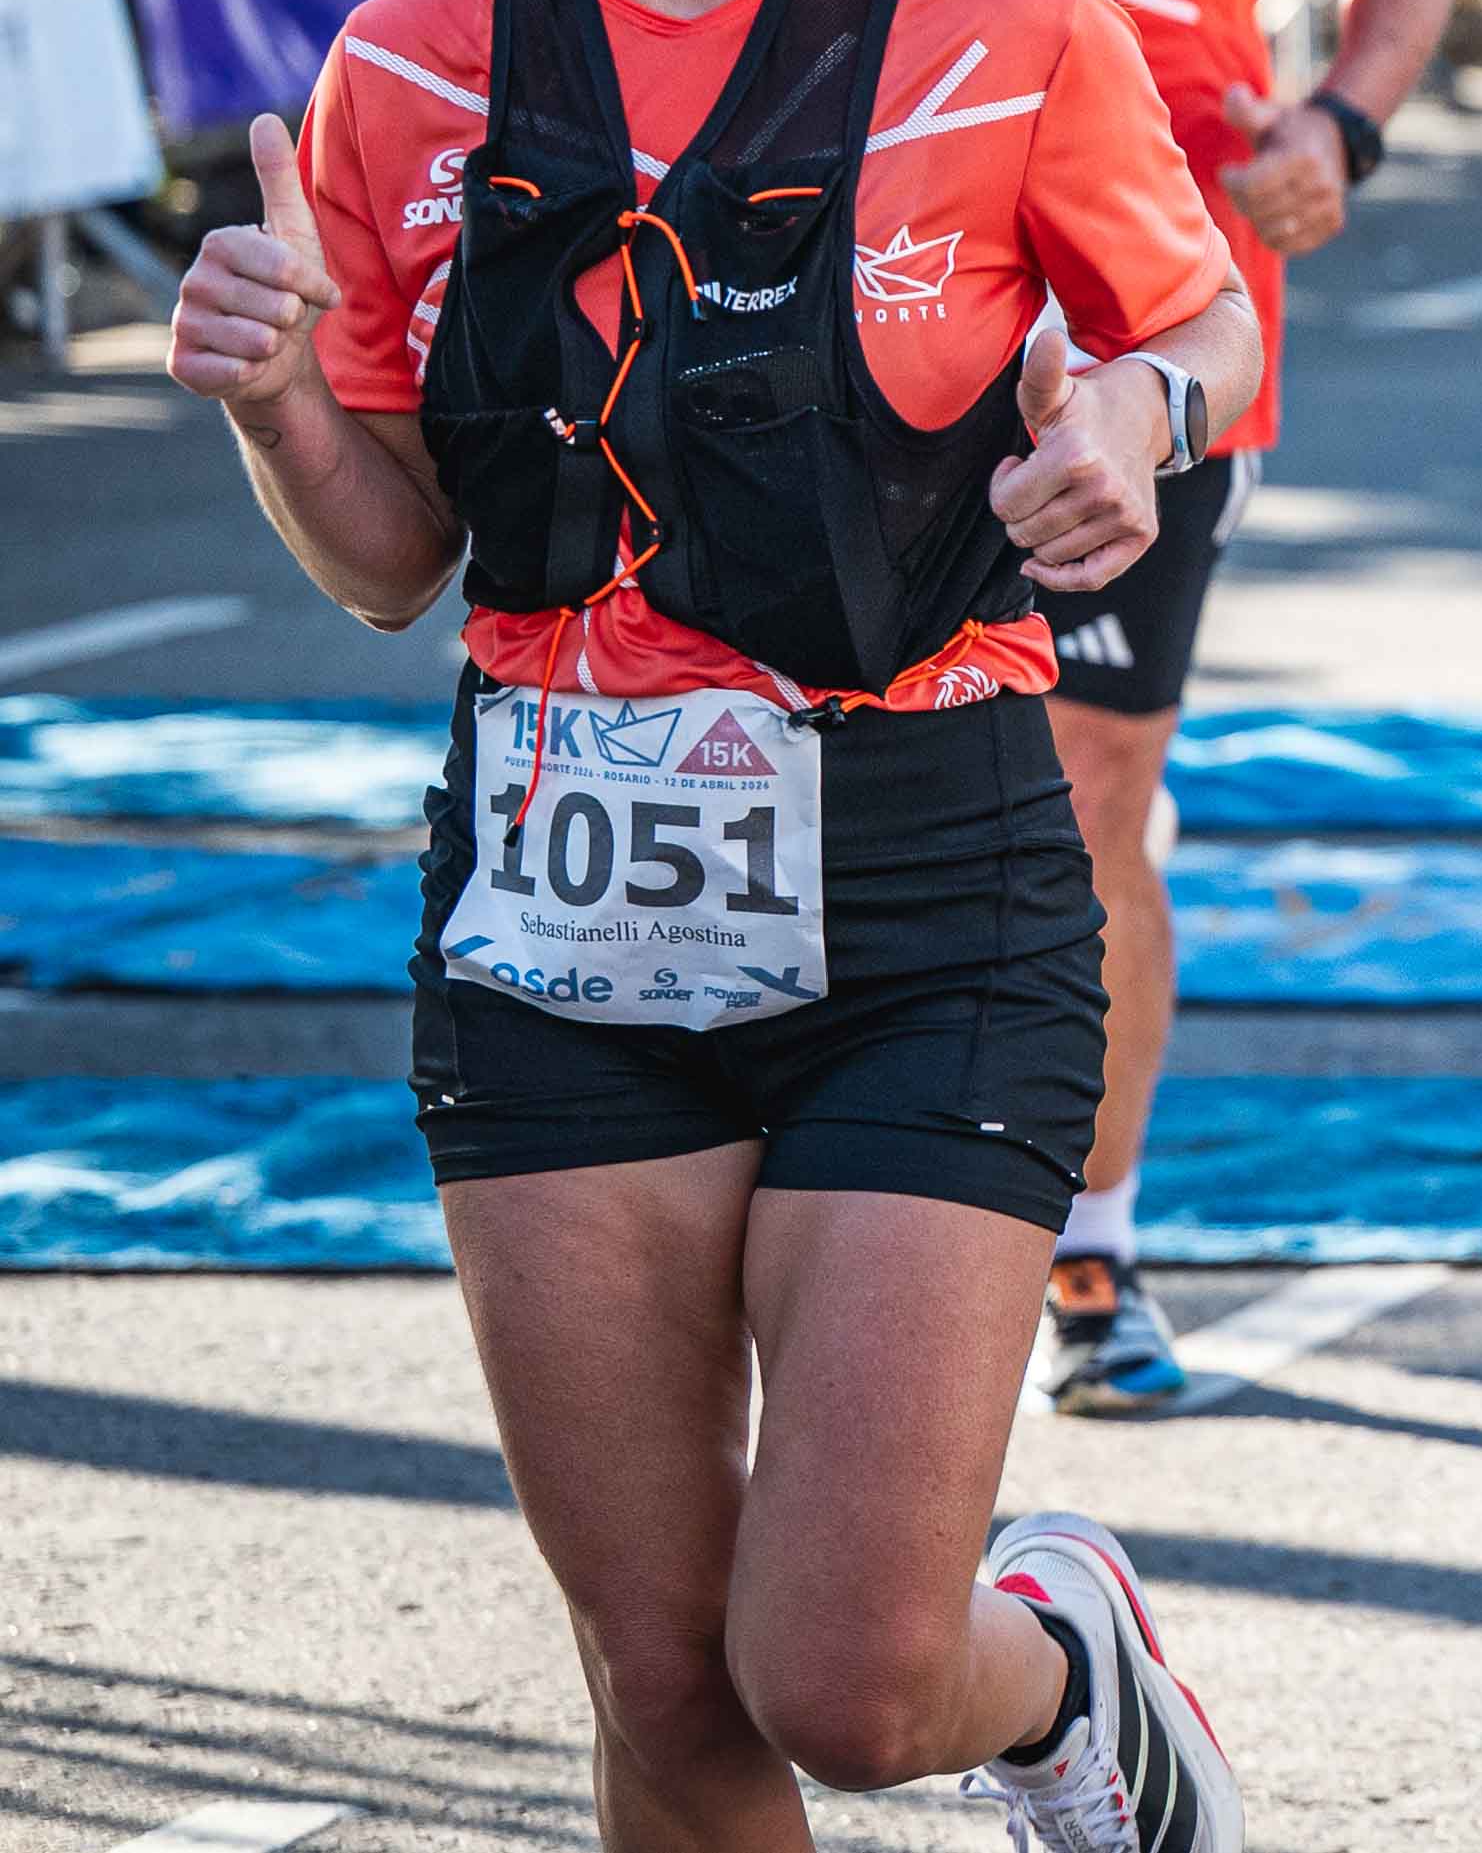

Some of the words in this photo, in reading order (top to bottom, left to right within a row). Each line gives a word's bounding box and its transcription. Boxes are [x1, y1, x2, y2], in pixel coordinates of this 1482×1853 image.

[722, 275, 798, 312] TERREX
[511, 699, 582, 758] 15K
[699, 740, 754, 768] 15K
[504, 755, 538, 769] PUERT
[604, 769, 650, 785] ROSARIO
[664, 777, 677, 787] 12
[681, 778, 697, 789] DE
[701, 780, 736, 790] ABRIL
[741, 781, 770, 791] 2026
[490, 783, 799, 916] 1051
[520, 911, 639, 943] Sebastianelli
[647, 920, 746, 948] Agostina
[490, 962, 614, 1004] osde
